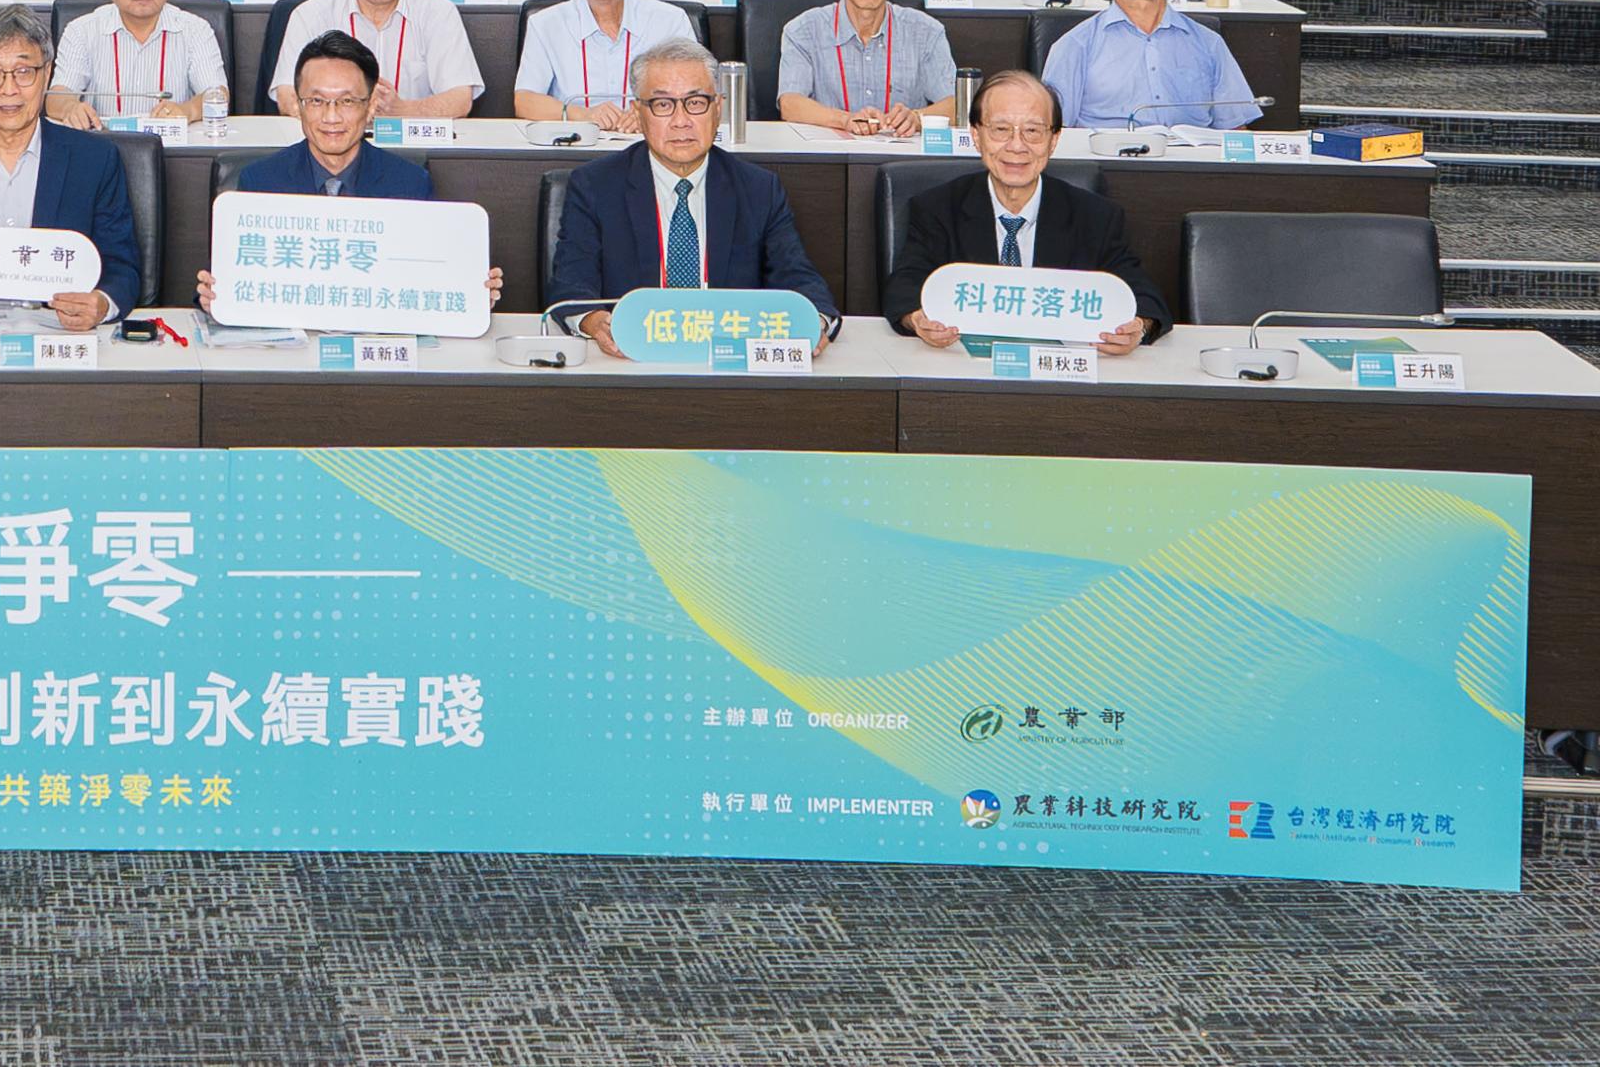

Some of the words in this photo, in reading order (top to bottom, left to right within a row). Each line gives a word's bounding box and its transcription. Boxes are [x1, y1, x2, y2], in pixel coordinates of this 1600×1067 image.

[237, 214, 320, 232] AGRICULTURE
[326, 218, 385, 235] NET-ZERO
[235, 233, 378, 274] 農業淨零
[234, 280, 467, 314] 從科研創新到永續實踐
[954, 282, 1103, 320] 科研落地
[643, 308, 792, 342] 低碳生活
[41, 344, 89, 360] 陳駿季
[1038, 354, 1089, 373] 楊秋忠
[1402, 363, 1455, 380] 王升陽
[703, 707, 794, 728] 主辦單位
[808, 712, 910, 730] ORGANIZER
[1018, 705, 1126, 731] 農業部
[702, 792, 793, 814] 執行單位
[808, 796, 934, 818] IMPLEMENTER
[1012, 794, 1202, 822] 農業科技研究院
[1287, 805, 1457, 836] 台灣經濟研究院
